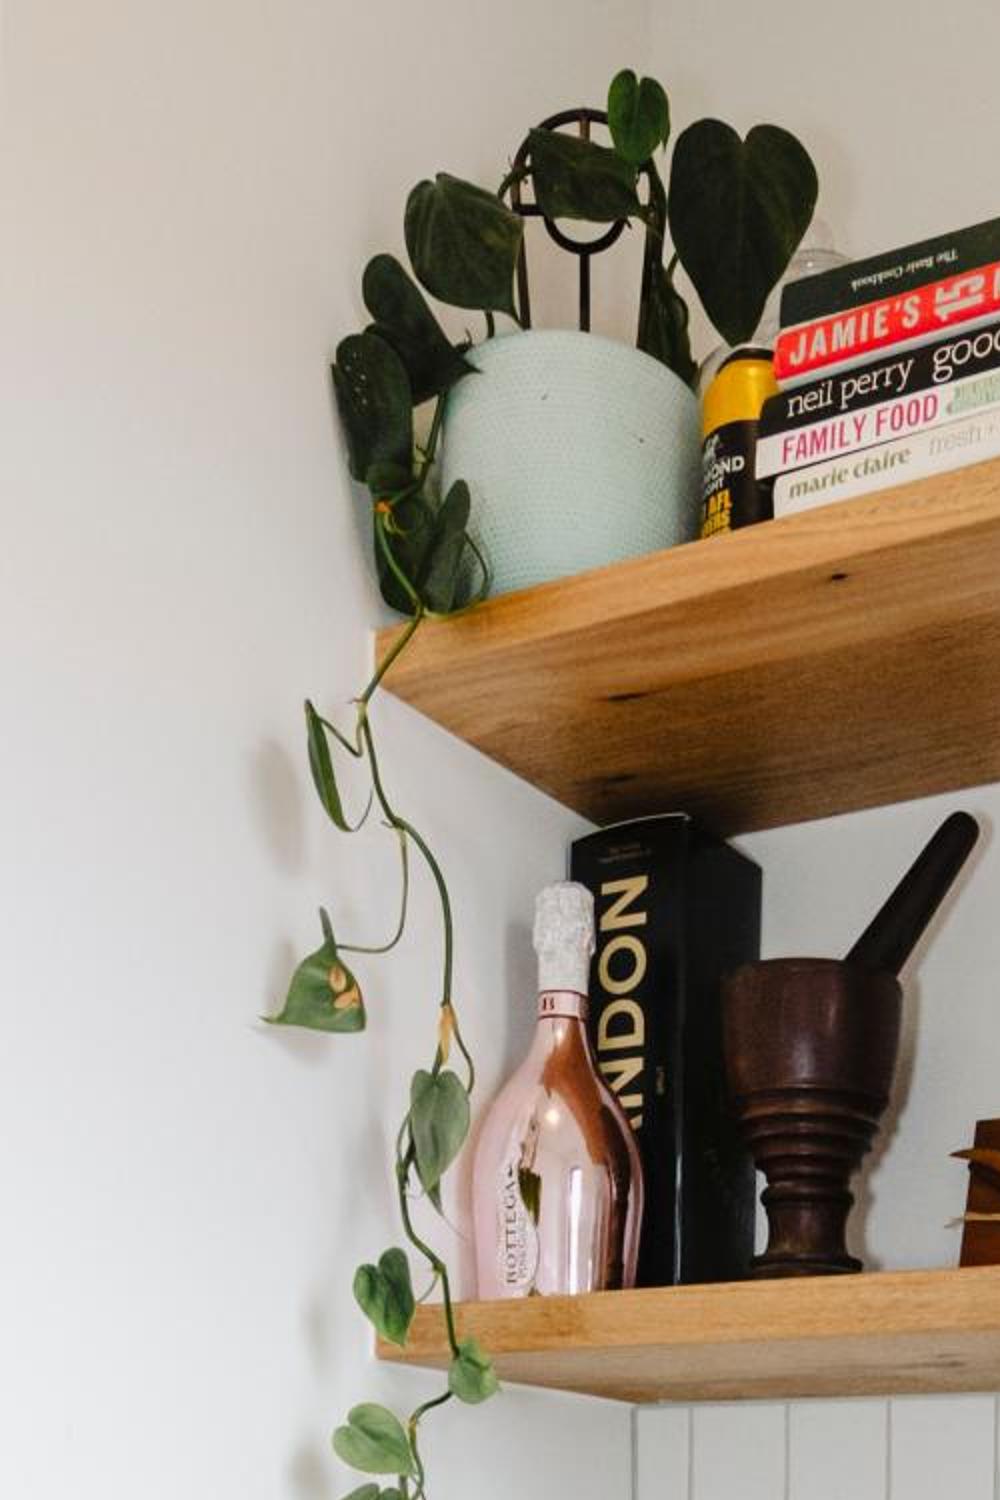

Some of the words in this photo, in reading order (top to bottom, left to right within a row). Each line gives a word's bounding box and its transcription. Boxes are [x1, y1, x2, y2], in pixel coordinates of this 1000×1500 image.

[936, 249, 958, 264] The
[789, 295, 920, 366] JAMIE'S
[786, 383, 833, 418] neil
[840, 358, 914, 410] perry
[782, 414, 867, 465] FAMILY
[875, 392, 939, 436] FOOD
[788, 467, 846, 499] marie
[853, 447, 912, 479] claire
[598, 875, 649, 1130] NDON
[505, 1180, 517, 1283] BOTTEGA
